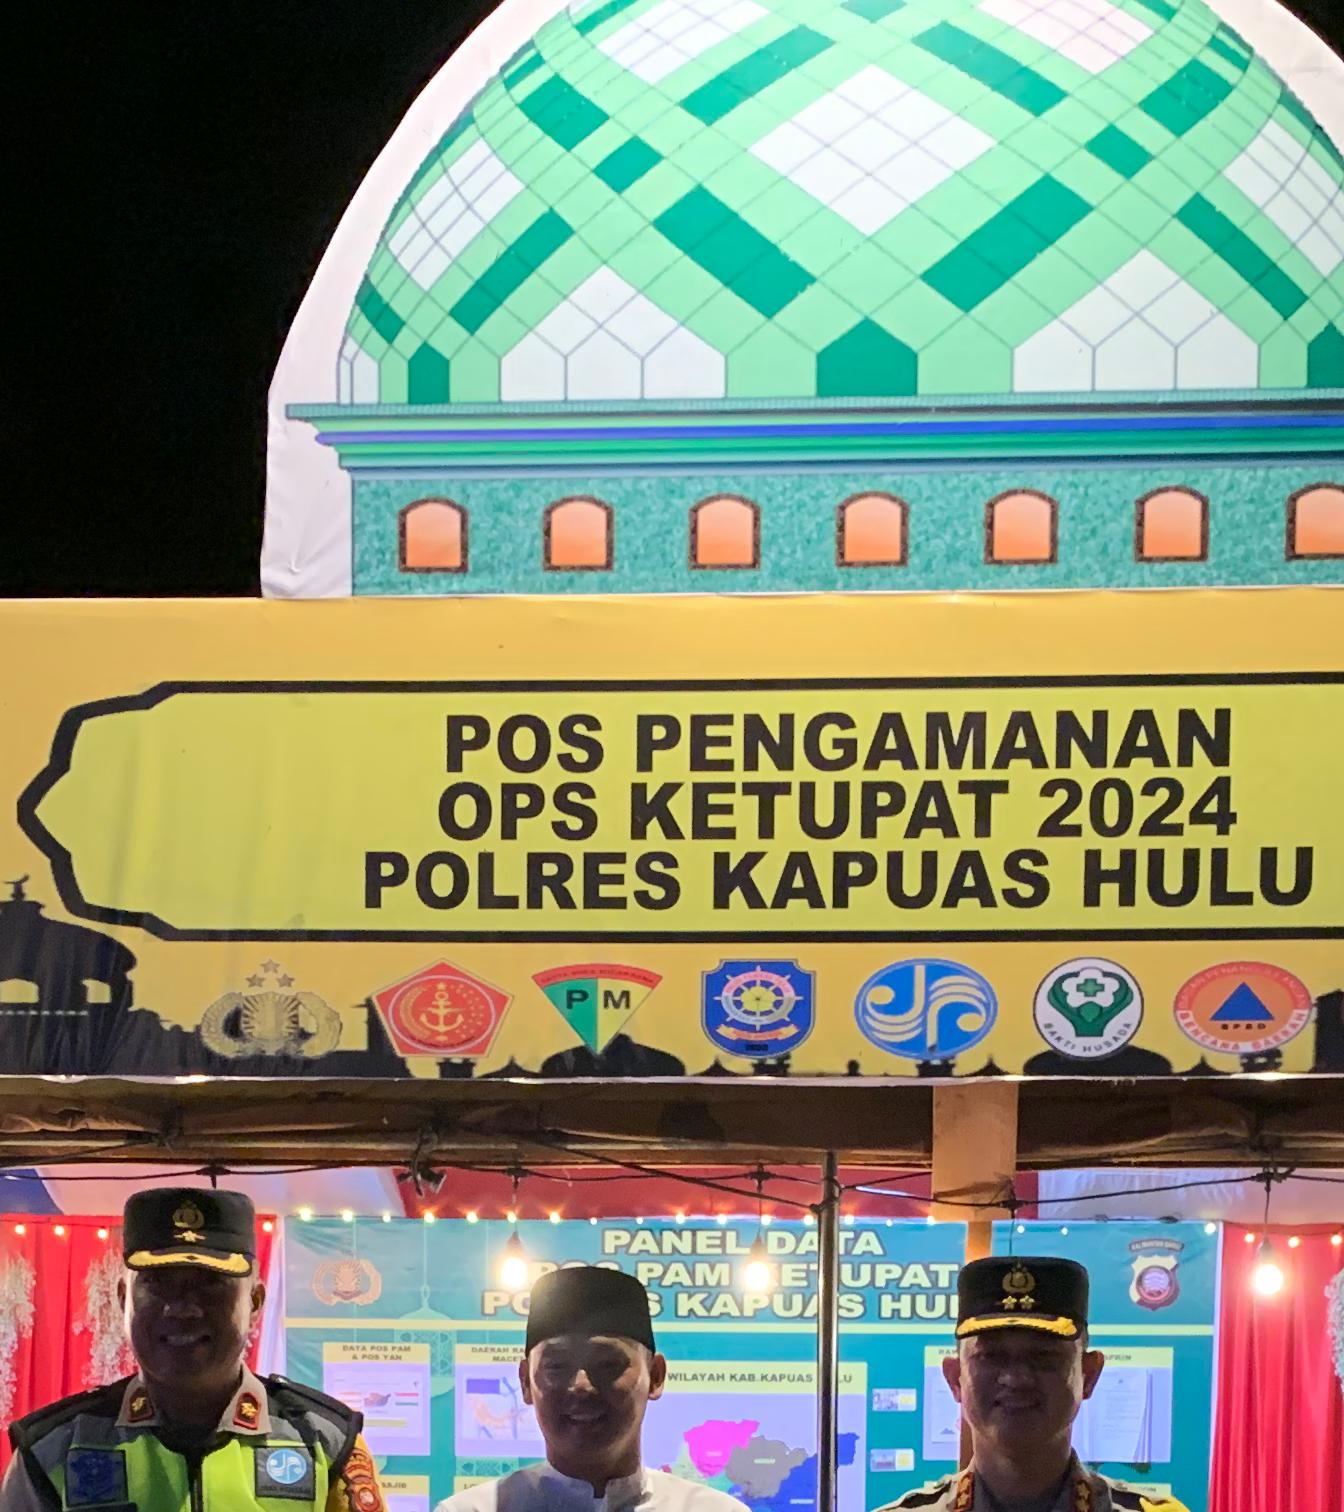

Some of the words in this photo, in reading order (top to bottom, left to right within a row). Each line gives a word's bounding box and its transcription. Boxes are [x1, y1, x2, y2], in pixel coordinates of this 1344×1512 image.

[446, 714, 604, 773] POS
[636, 707, 1232, 772] PENGAMANAN
[438, 780, 598, 843] OPS
[630, 778, 1010, 841] KETUPAT
[1037, 776, 1238, 839] 2024
[363, 850, 680, 911] POLRES
[711, 848, 1052, 911] KAPUAS
[1084, 845, 1315, 908] HULU
[602, 1228, 752, 1256] PANEL
[635, 1261, 731, 1288] PAM
[342, 1344, 367, 1352] DATA
[370, 1344, 389, 1352] POS
[391, 1345, 412, 1353] PAM
[667, 1372, 726, 1383] WILAYAH
